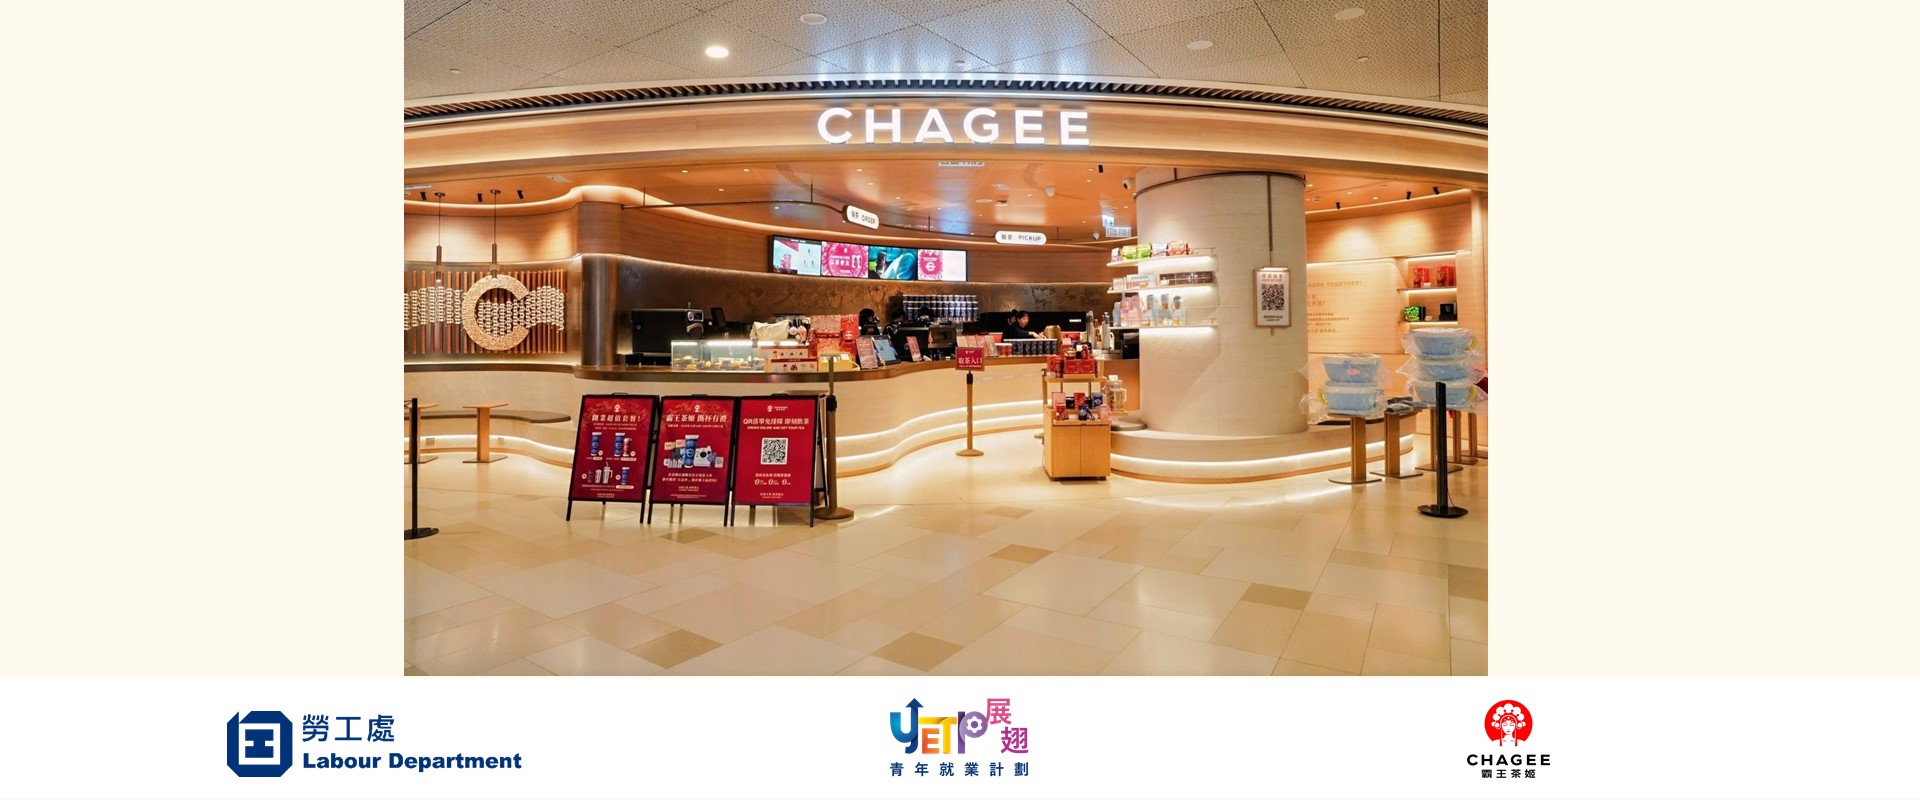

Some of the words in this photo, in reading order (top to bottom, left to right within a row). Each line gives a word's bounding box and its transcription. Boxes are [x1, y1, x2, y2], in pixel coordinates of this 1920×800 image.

[817, 106, 1090, 146] CHAGEE
[862, 214, 876, 224] ORDER
[1018, 234, 1042, 242] PICKUP
